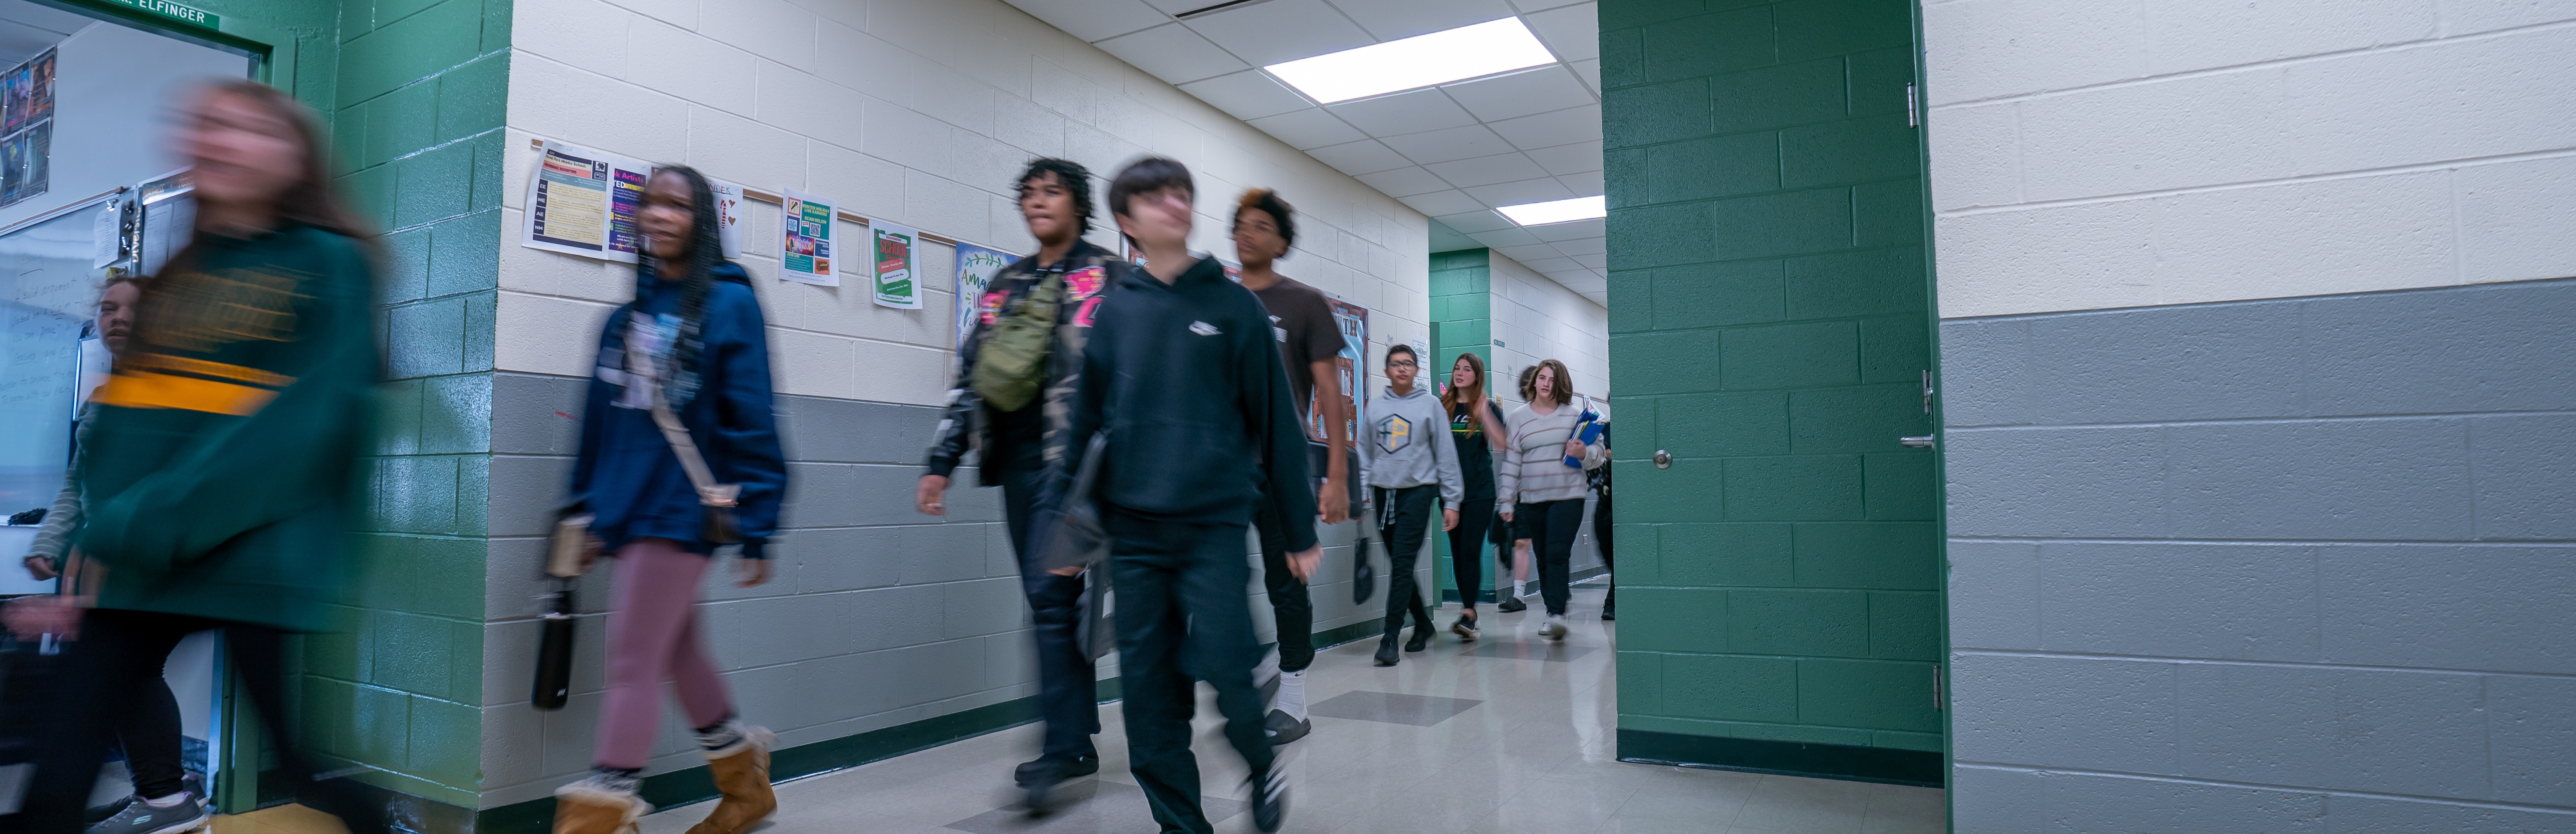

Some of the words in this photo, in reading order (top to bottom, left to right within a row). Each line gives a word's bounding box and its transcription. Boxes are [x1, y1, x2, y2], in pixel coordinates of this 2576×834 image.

[139, 0, 205, 23] ELFINGER
[622, 172, 644, 183] Artists
[880, 239, 909, 259] SCHOOL
